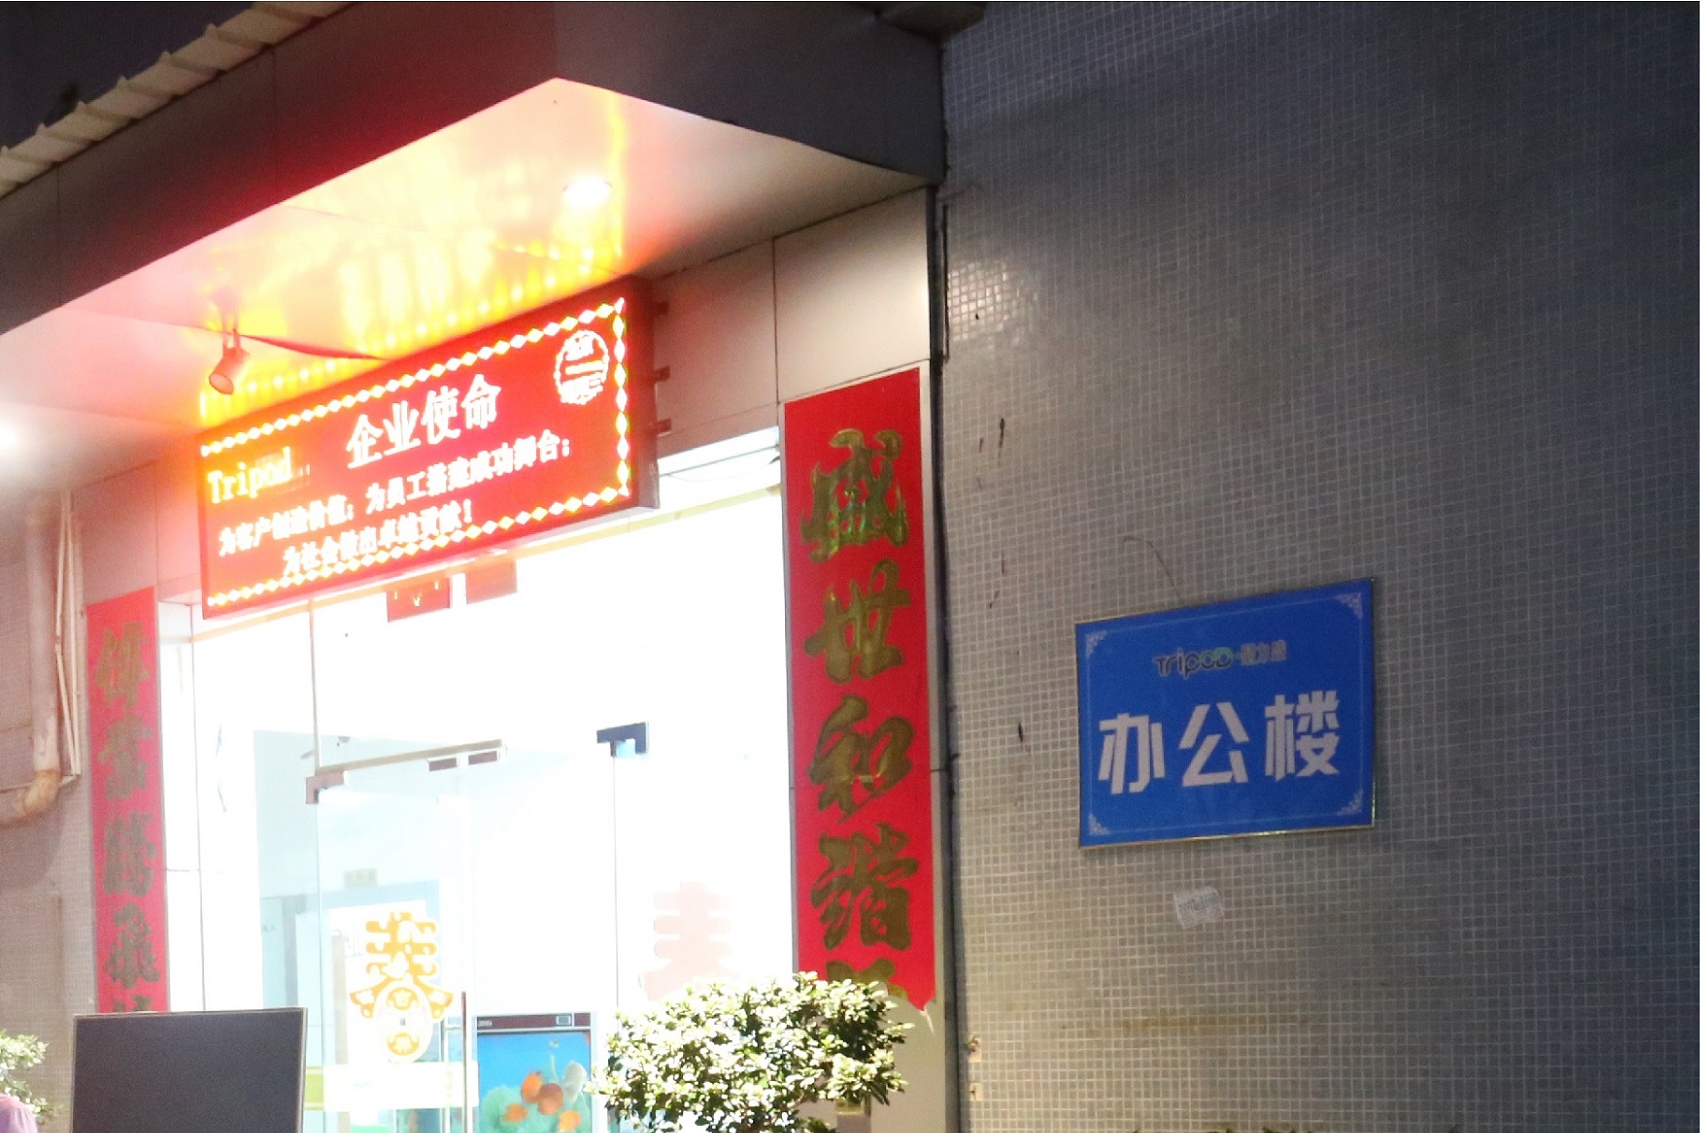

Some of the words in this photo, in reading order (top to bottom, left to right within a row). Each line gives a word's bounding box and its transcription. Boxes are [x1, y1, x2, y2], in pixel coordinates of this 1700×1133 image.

[345, 374, 502, 469] 企业使命
[207, 446, 292, 503] Tripod
[1098, 690, 1340, 795] 办公楼
